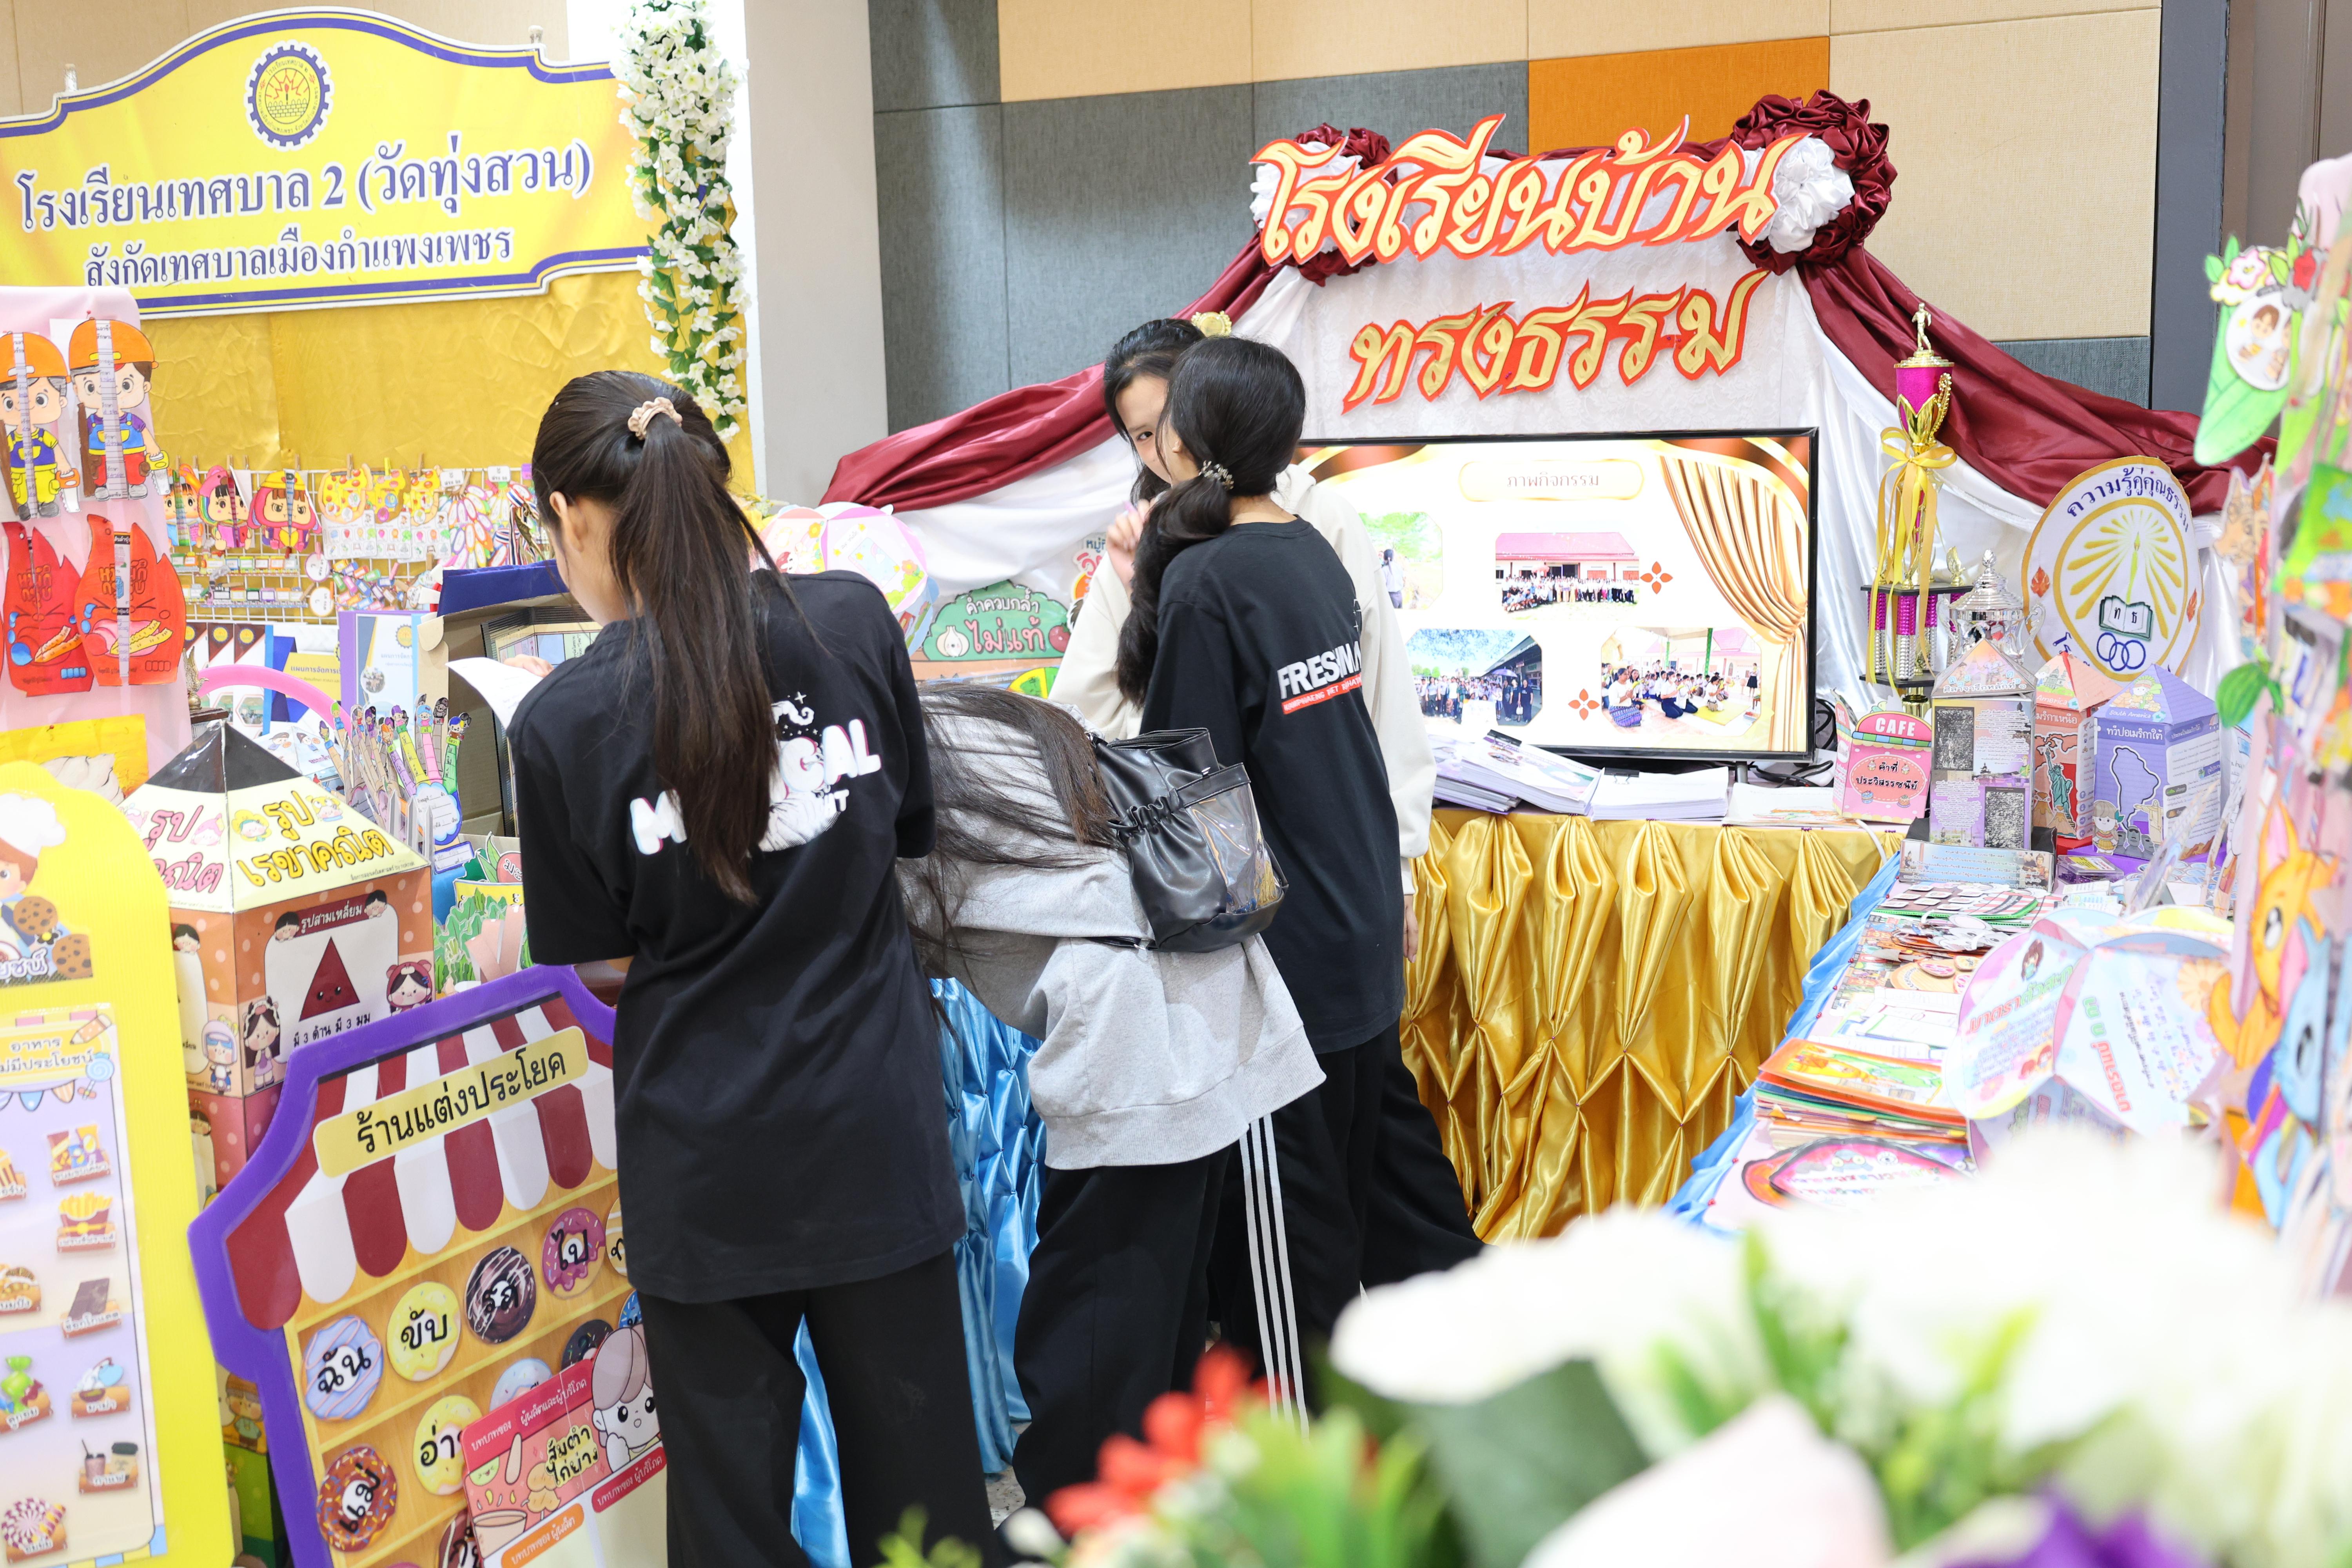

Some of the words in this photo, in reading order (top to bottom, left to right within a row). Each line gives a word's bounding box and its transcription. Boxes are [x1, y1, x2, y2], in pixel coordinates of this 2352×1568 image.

[16, 162, 310, 232] โรงเรียนเทศบาล
[324, 167, 345, 207] 2
[358, 132, 593, 217] (วัดทุ่งสวน)
[1251, 113, 1812, 267] โรงเรียนบ้าน
[85, 225, 512, 287] สังกัดเทศบาลเมืองกำแพงเพชร
[1341, 269, 1769, 416] ทรงธรรม
[1507, 471, 1599, 487] ภาพกิจกรรม
[2067, 466, 2189, 532] ความรู้คู่คุณธรรม
[965, 588, 1040, 615] คำควบกล้ำ
[2114, 606, 2121, 620] ท
[2131, 611, 2138, 624] ธ
[964, 616, 1046, 653] ไม่แท้
[1943, 681, 2016, 693] ศิลาจารึกหลักที่
[2036, 694, 2069, 706] America
[1875, 717, 1916, 737] CAFE
[2036, 711, 2078, 725] มริกาเหนือ
[2106, 726, 2163, 741] ทวีปอเมริกาใต้
[1878, 761, 1899, 773] คำที่
[143, 805, 205, 853] รูป
[262, 790, 315, 840] รูป
[237, 825, 394, 887] เรขาคณิต
[300, 900, 362, 935] รูปสามเหลี่ยม
[1969, 965, 2074, 1033] มาตราตัวสะก
[293, 1031, 300, 1047] มี
[304, 1032, 309, 1044] 3
[312, 1024, 332, 1042] ด้าน
[335, 1019, 343, 1035] มี
[346, 1018, 352, 1030] 3
[356, 1012, 371, 1026] มม
[0, 1049, 95, 1074] ม่มีประโยชน์
[356, 1049, 566, 1154] ร้านแต่งประโยค
[550, 1229, 589, 1271] ไป
[0, 1297, 30, 1309] นมปัง
[400, 1309, 448, 1350] ขับ
[318, 1347, 372, 1394] ฉัน
[520, 1378, 588, 1426] ผู้ผลิตและผู้บริโภค
[420, 1425, 463, 1467] อ่า
[470, 1420, 512, 1452] บทบาทของ
[547, 1427, 592, 1463] ส้มตำ
[546, 1448, 599, 1486] ไก่ย่าง
[597, 1475, 634, 1507] บทบาทของ
[634, 1455, 663, 1484] ผู้บริโภค
[339, 1462, 381, 1534] แม่
[511, 1532, 551, 1566] บทบาทของ
[551, 1515, 576, 1541] ผู้ผลิต
